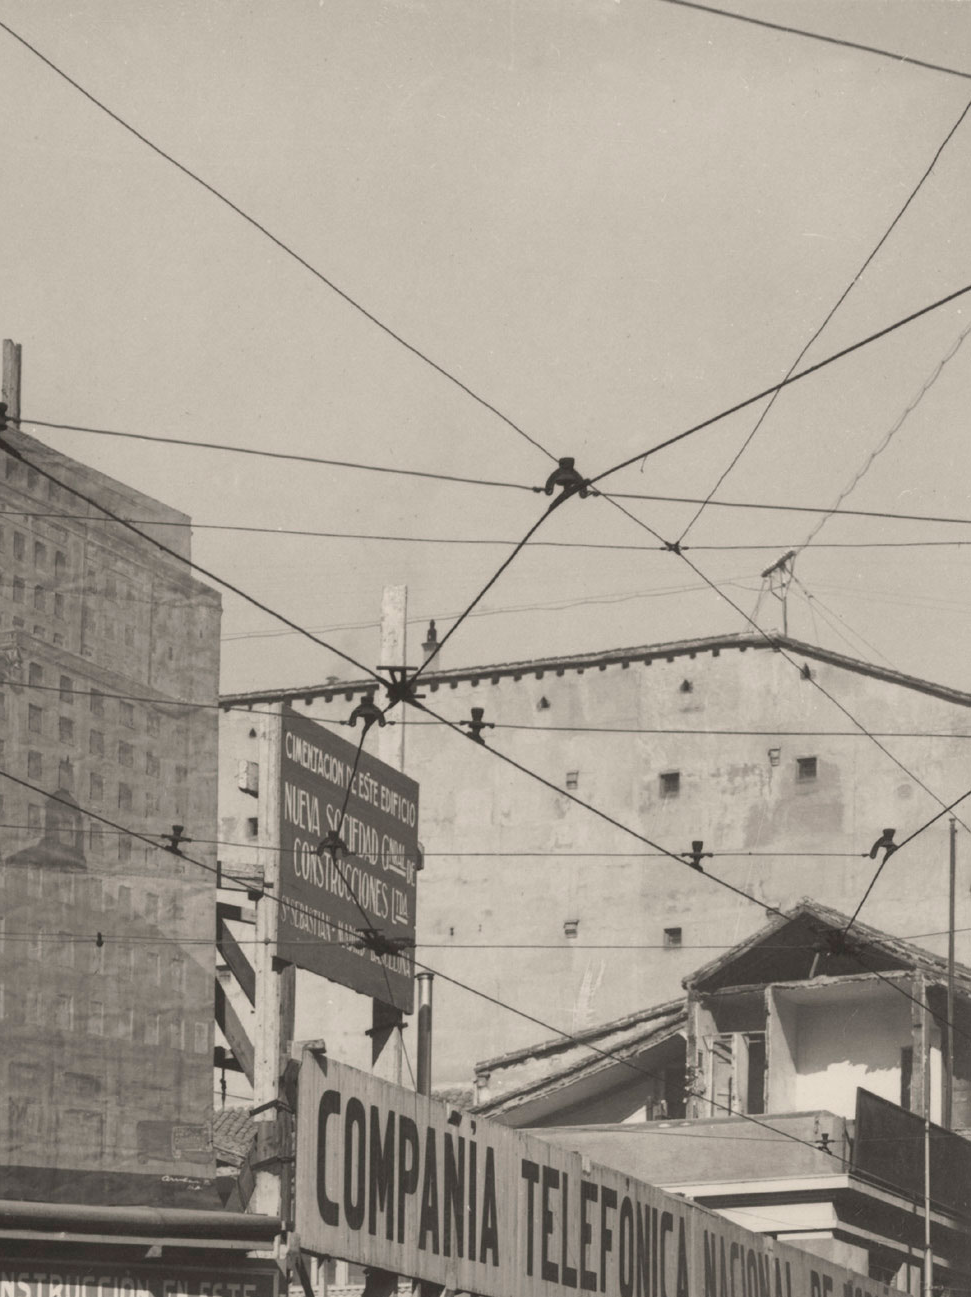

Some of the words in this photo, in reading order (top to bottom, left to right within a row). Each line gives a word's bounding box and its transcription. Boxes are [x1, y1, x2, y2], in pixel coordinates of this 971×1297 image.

[285, 731, 344, 788] CIMENTACION
[345, 764, 357, 795] DE
[381, 785, 416, 828] EDIFICIO
[284, 781, 321, 837] NUEVA
[326, 803, 379, 866] SOCIEDAD
[293, 837, 389, 920] CONSTRUCCIONES
